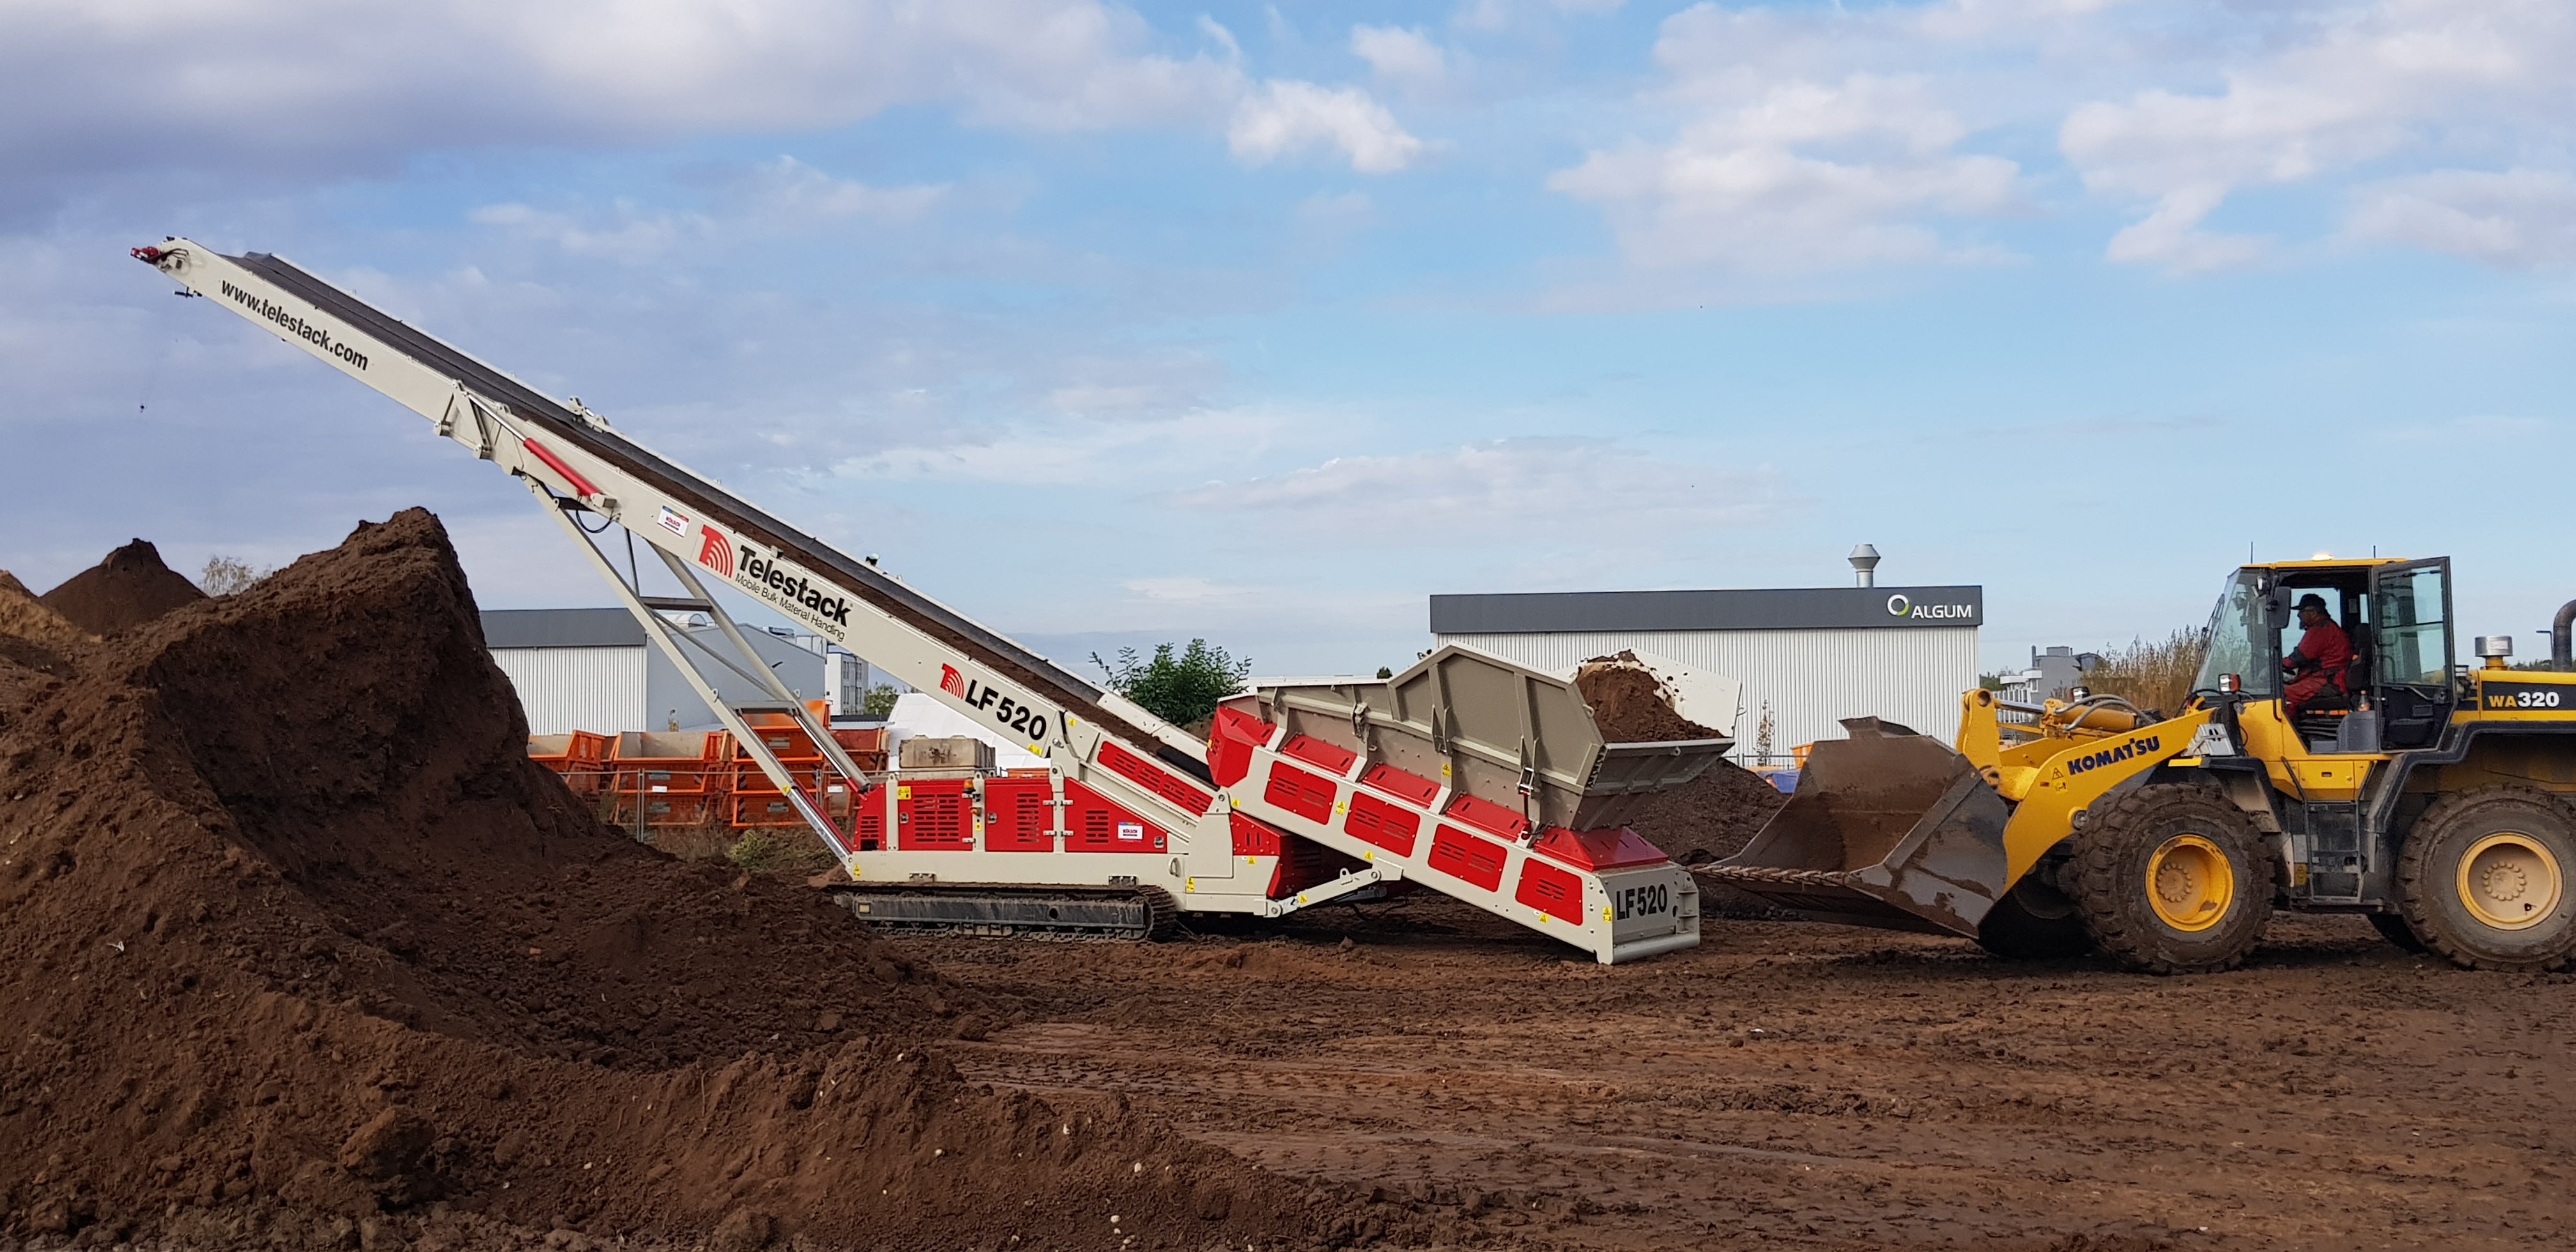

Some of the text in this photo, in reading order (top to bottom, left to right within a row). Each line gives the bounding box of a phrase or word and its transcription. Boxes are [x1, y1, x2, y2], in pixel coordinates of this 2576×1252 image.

[222, 279, 369, 371] www.telestack.com
[735, 573, 845, 643] Mobile Bulk Material Handling
[739, 544, 852, 627] Telestack
[1911, 604, 1972, 619] ALGUM
[2488, 691, 2560, 708] WA320
[2066, 735, 2160, 775] KOMATSU
